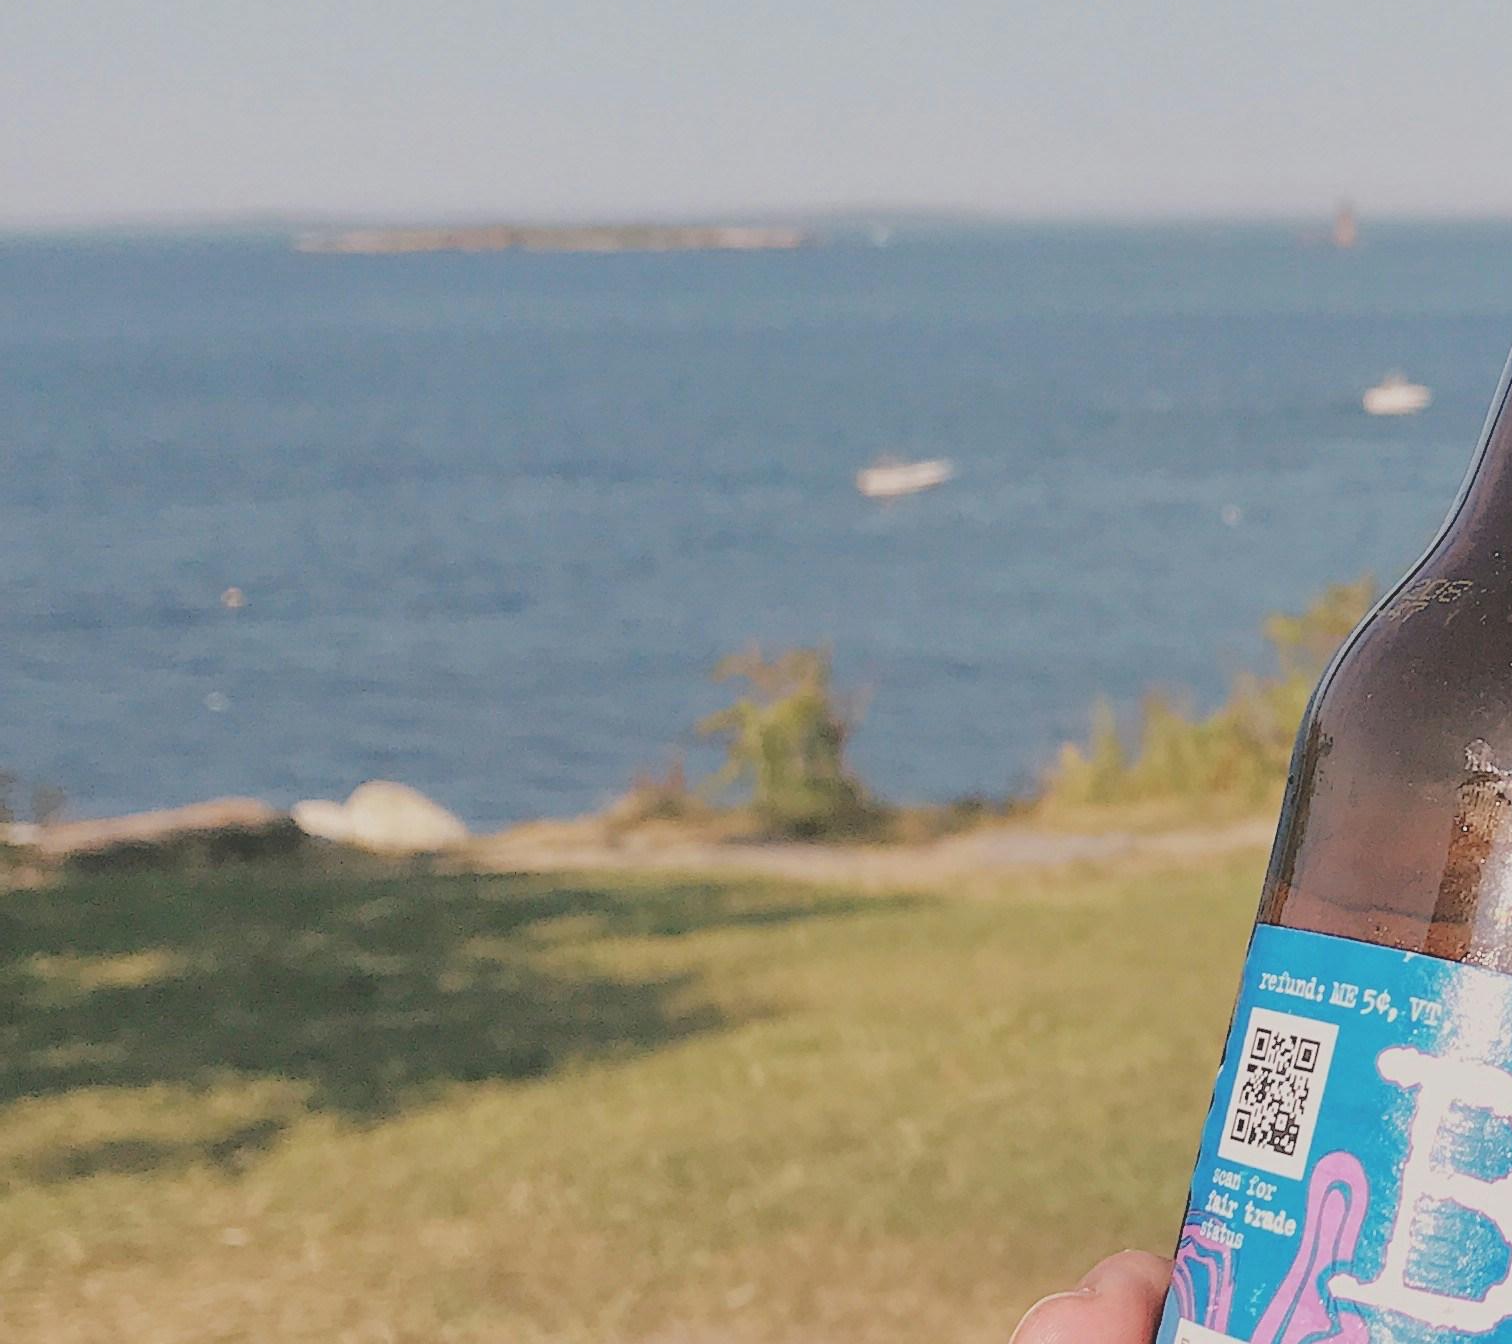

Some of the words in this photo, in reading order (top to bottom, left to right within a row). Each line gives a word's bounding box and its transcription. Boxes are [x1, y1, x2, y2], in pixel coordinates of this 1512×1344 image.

[1259, 971, 1325, 1002] refund:
[1329, 981, 1358, 1008] ME
[1212, 1168, 1241, 1191] scan
[1246, 1175, 1277, 1201] for
[1205, 1190, 1239, 1219] fair
[1244, 1200, 1296, 1237] trade
[1200, 1218, 1244, 1249] status
